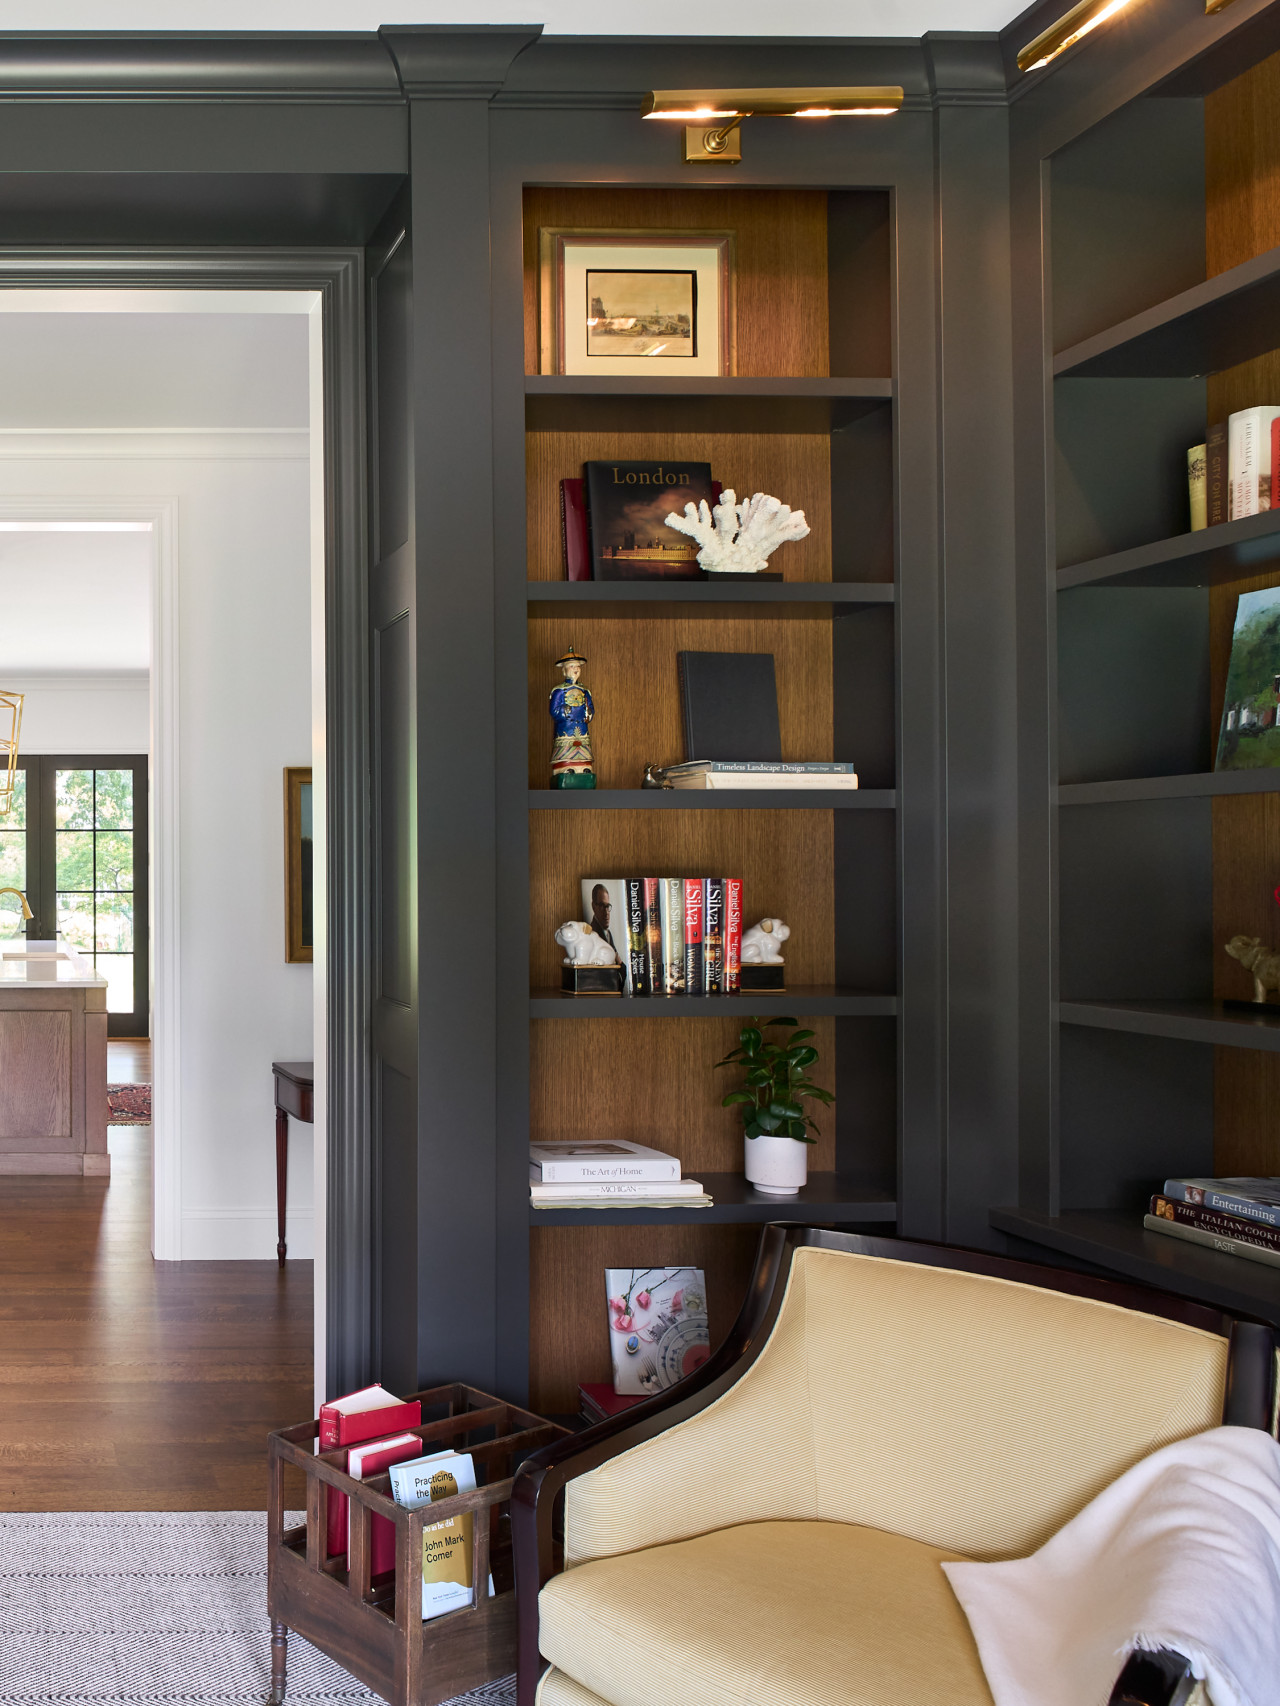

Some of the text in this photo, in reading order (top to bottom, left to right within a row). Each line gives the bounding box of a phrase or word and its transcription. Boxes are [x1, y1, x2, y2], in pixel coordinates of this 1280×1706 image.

[612, 467, 690, 485] London
[1212, 456, 1221, 479] CITY
[1212, 482, 1221, 498] ON
[1212, 501, 1221, 522] FIRE
[717, 763, 746, 771] Timeless
[747, 764, 781, 772] Landscape
[782, 764, 805, 773] Design
[670, 880, 680, 908] Daniel
[731, 882, 740, 910] Daniel
[630, 882, 642, 933] Daniel Silva
[686, 889, 702, 926] Silva
[707, 889, 722, 925] Silva
[650, 912, 659, 929] Silva
[671, 909, 680, 931] Silva
[730, 911, 740, 933] Silva
[729, 943, 738, 968] English
[631, 958, 639, 975] Spies
[687, 948, 696, 986] WOMAN
[729, 969, 738, 982] Spy
[581, 1167, 643, 1176] The Art of Home
[1176, 1206, 1196, 1218] THE
[1201, 1213, 1242, 1231] ITALIAN
[1212, 1195, 1276, 1224] Entertaining
[1193, 1220, 1275, 1250] ENCYCLOPEDIA
[1214, 1239, 1236, 1254] TASTE
[414, 1472, 453, 1487] Practicing
[416, 1485, 447, 1499] the Way
[436, 1522, 445, 1530] he
[445, 1518, 455, 1528] did
[424, 1534, 465, 1552] John Mark
[426, 1550, 453, 1563] Comer
